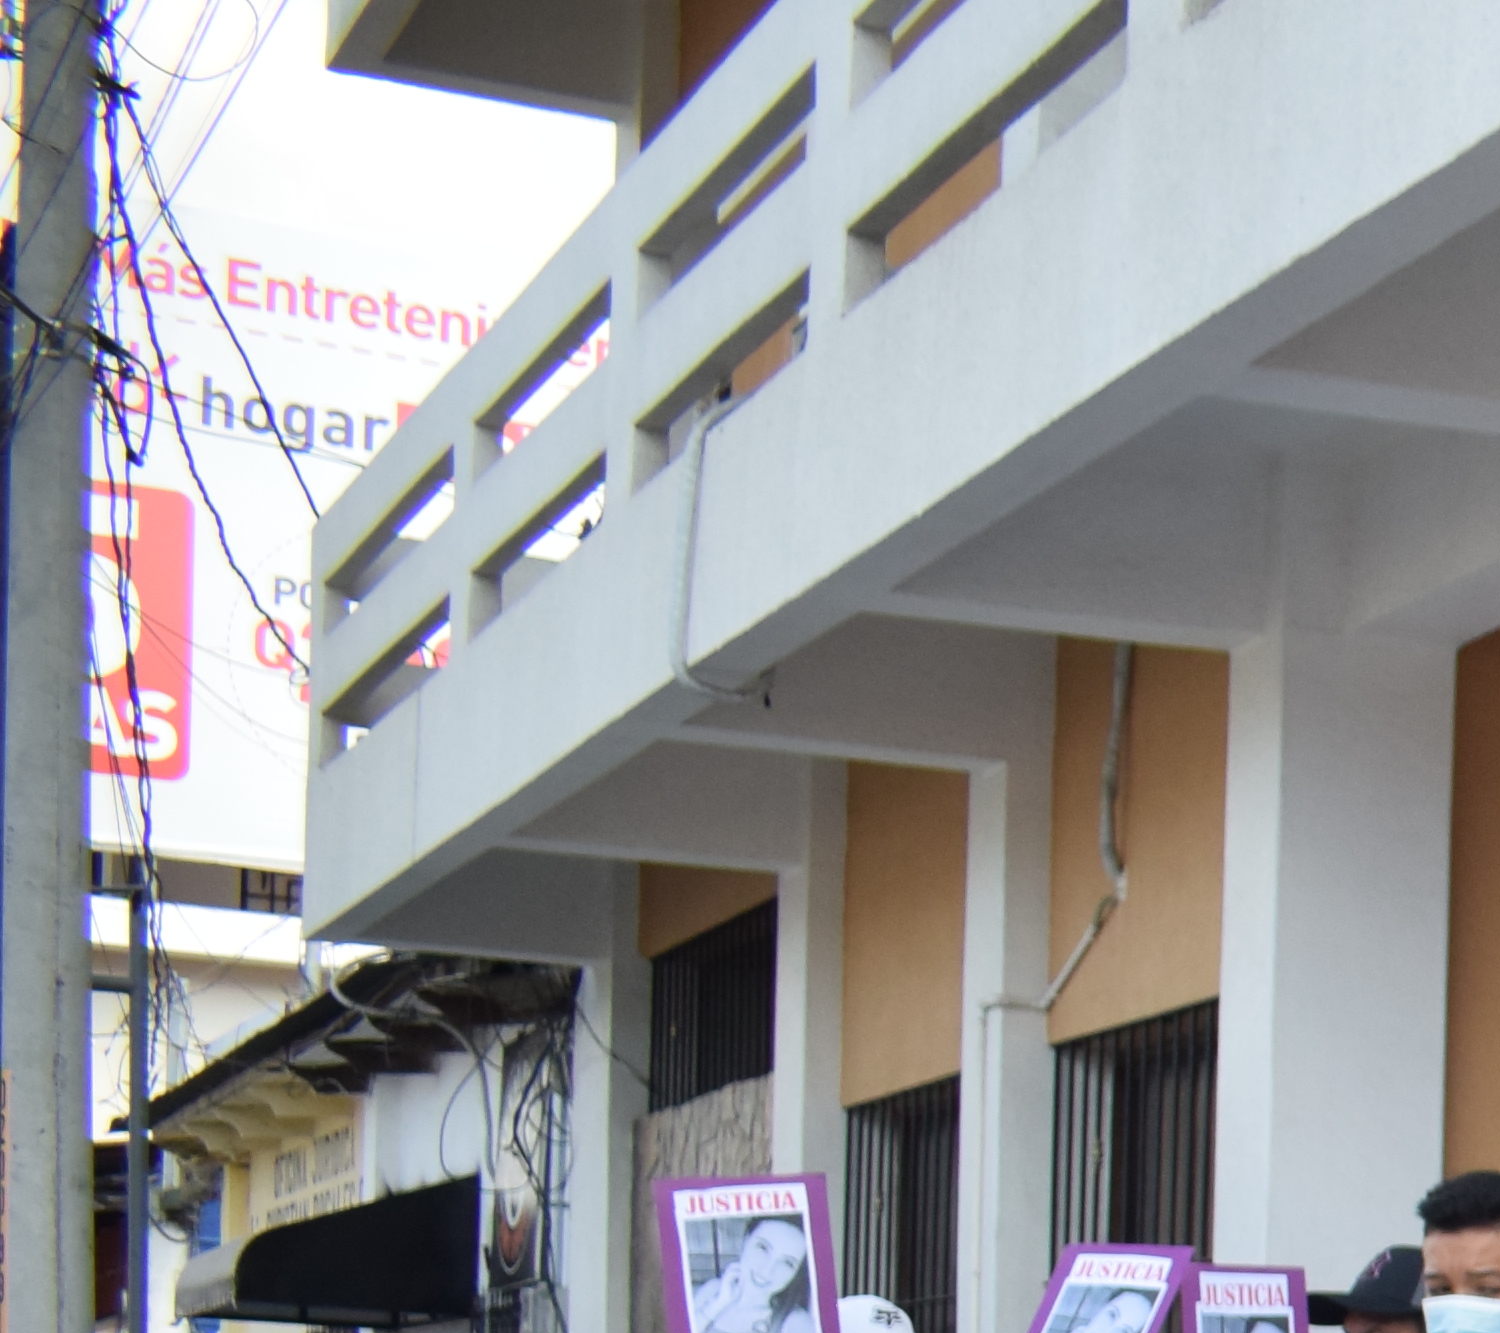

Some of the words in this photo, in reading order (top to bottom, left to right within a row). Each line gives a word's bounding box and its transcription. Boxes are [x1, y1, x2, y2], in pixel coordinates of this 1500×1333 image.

[226, 257, 497, 347] Entreteni
[201, 375, 390, 455] hogar
[684, 1188, 798, 1216] JUSTICIA
[1068, 1258, 1167, 1282] JUSTICIA
[1200, 1279, 1288, 1308] JUSTICIA
